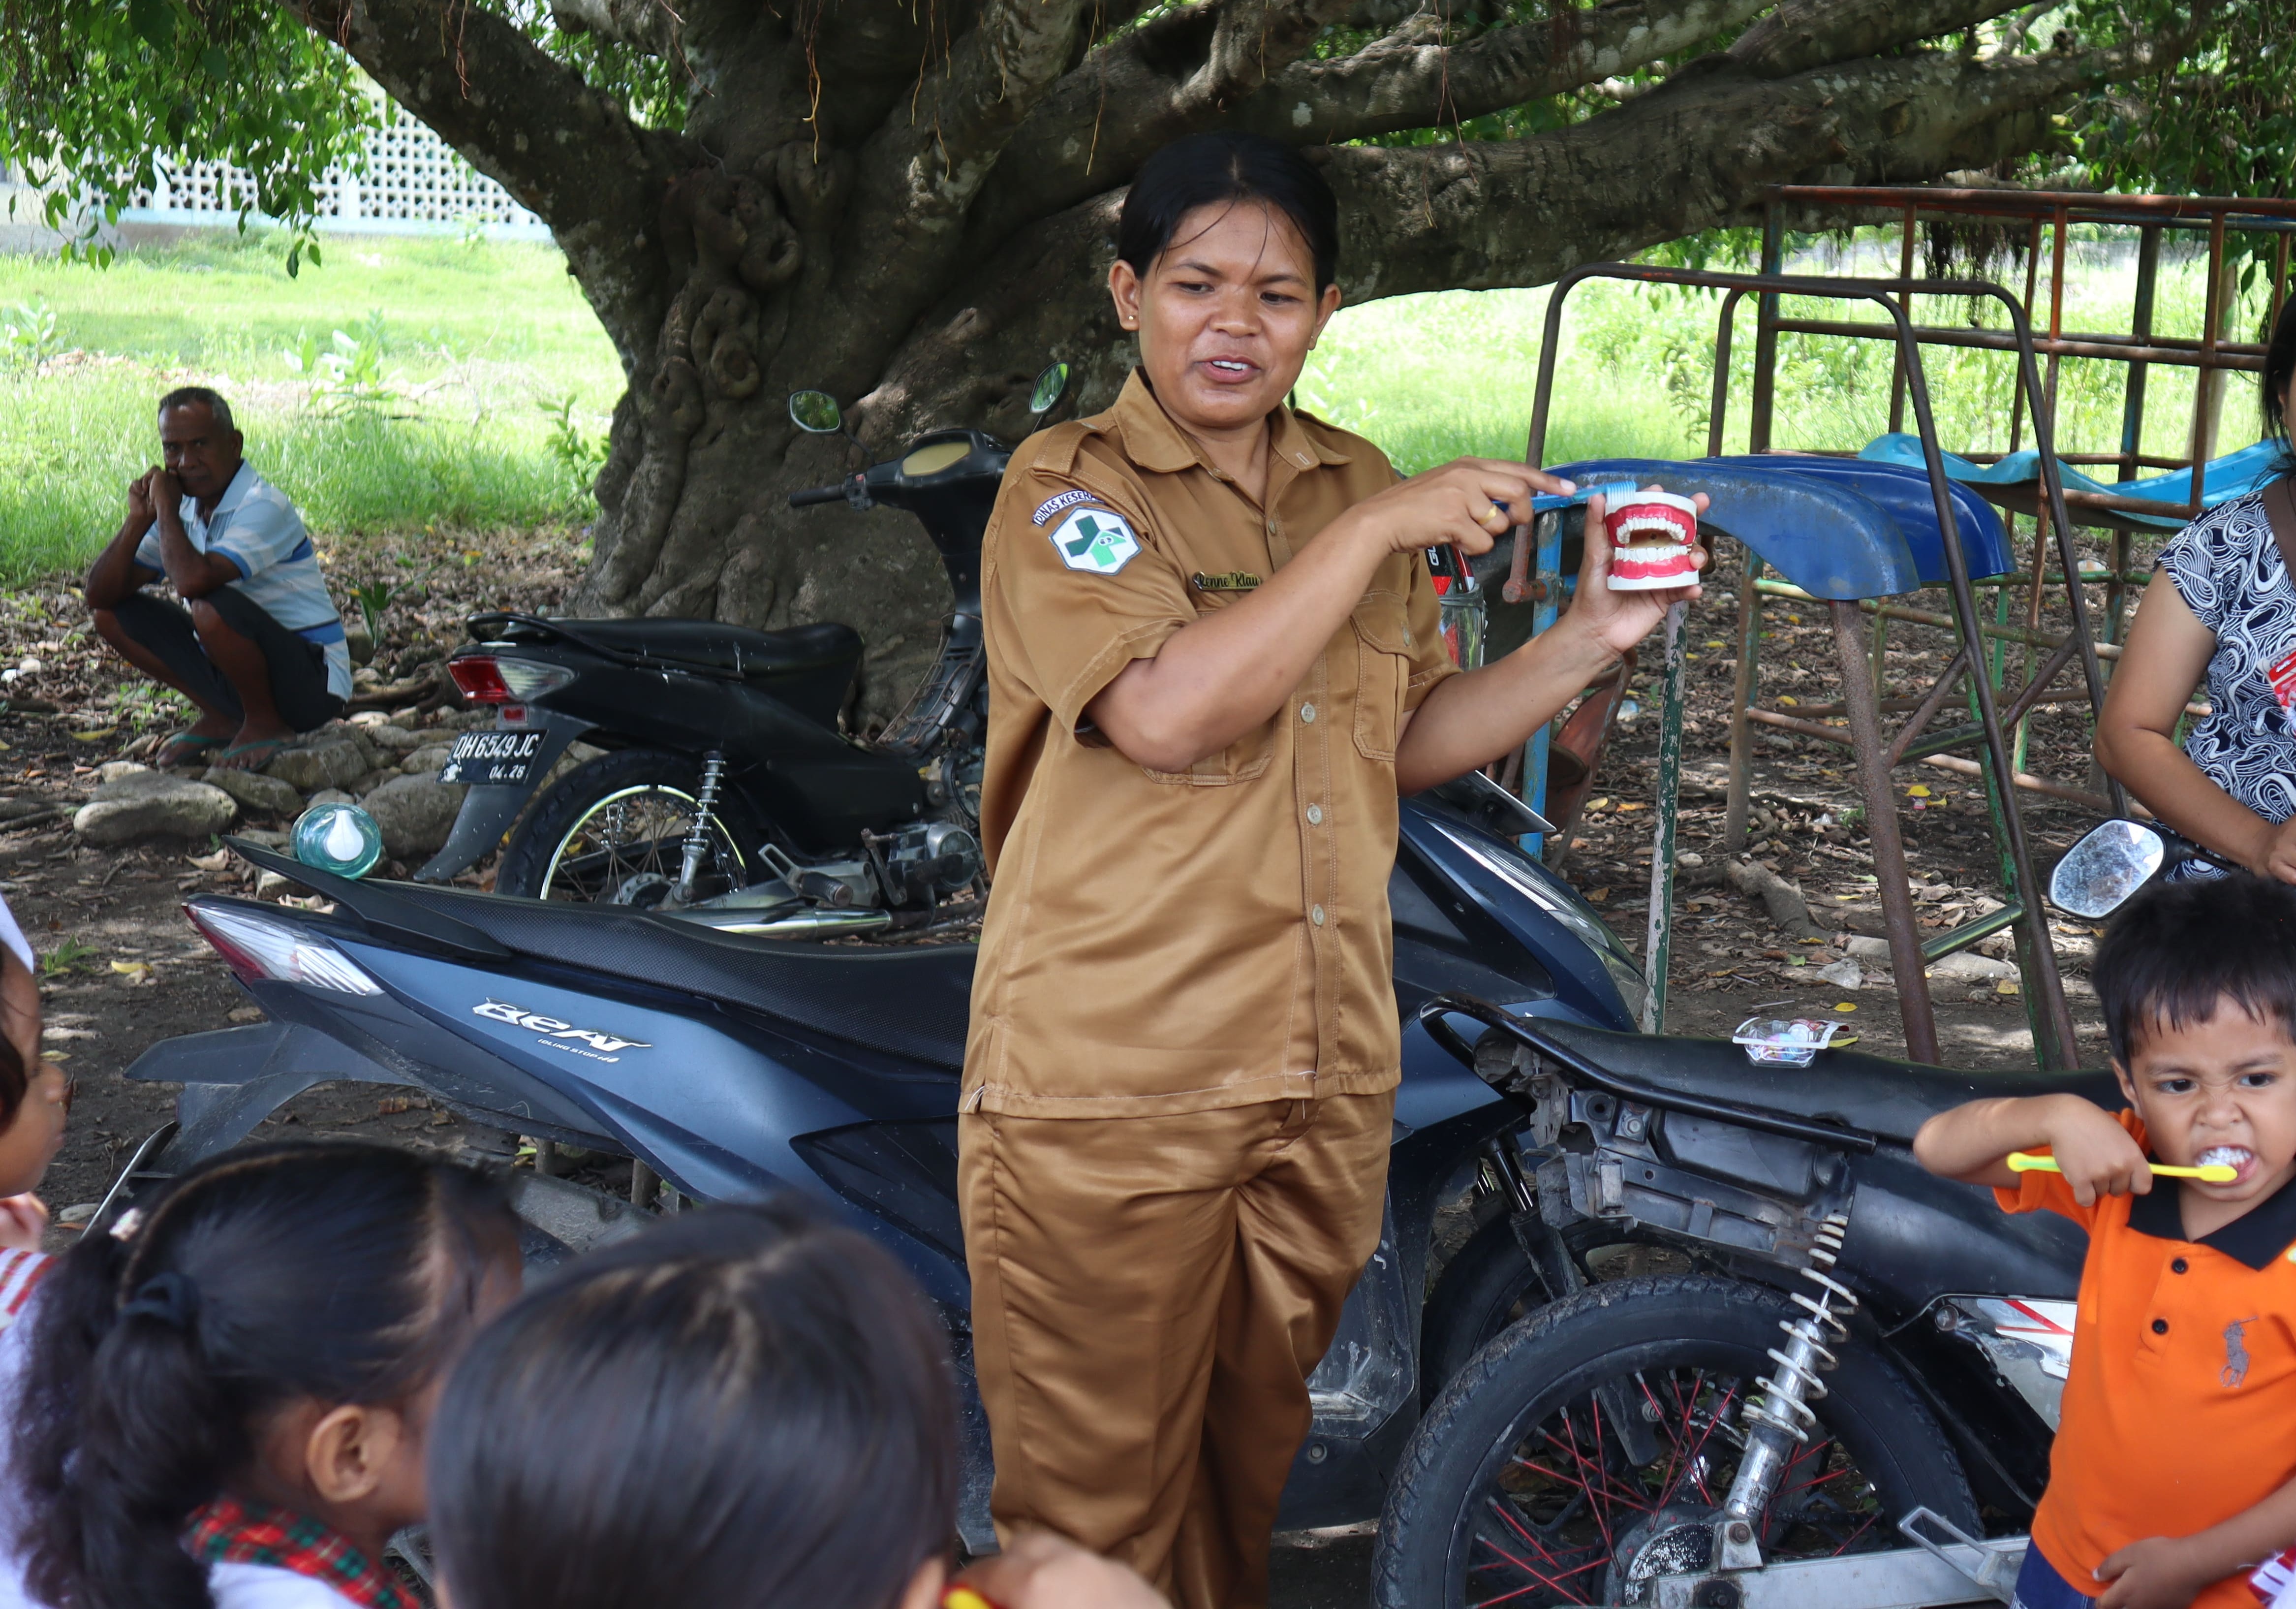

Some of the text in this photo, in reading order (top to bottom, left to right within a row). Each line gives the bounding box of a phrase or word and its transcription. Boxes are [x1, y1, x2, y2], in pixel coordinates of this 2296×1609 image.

[1034, 500, 1059, 526] DINAS
[453, 733, 539, 759] DH 6549 JC
[537, 1038, 598, 1058] IDLING STOP
